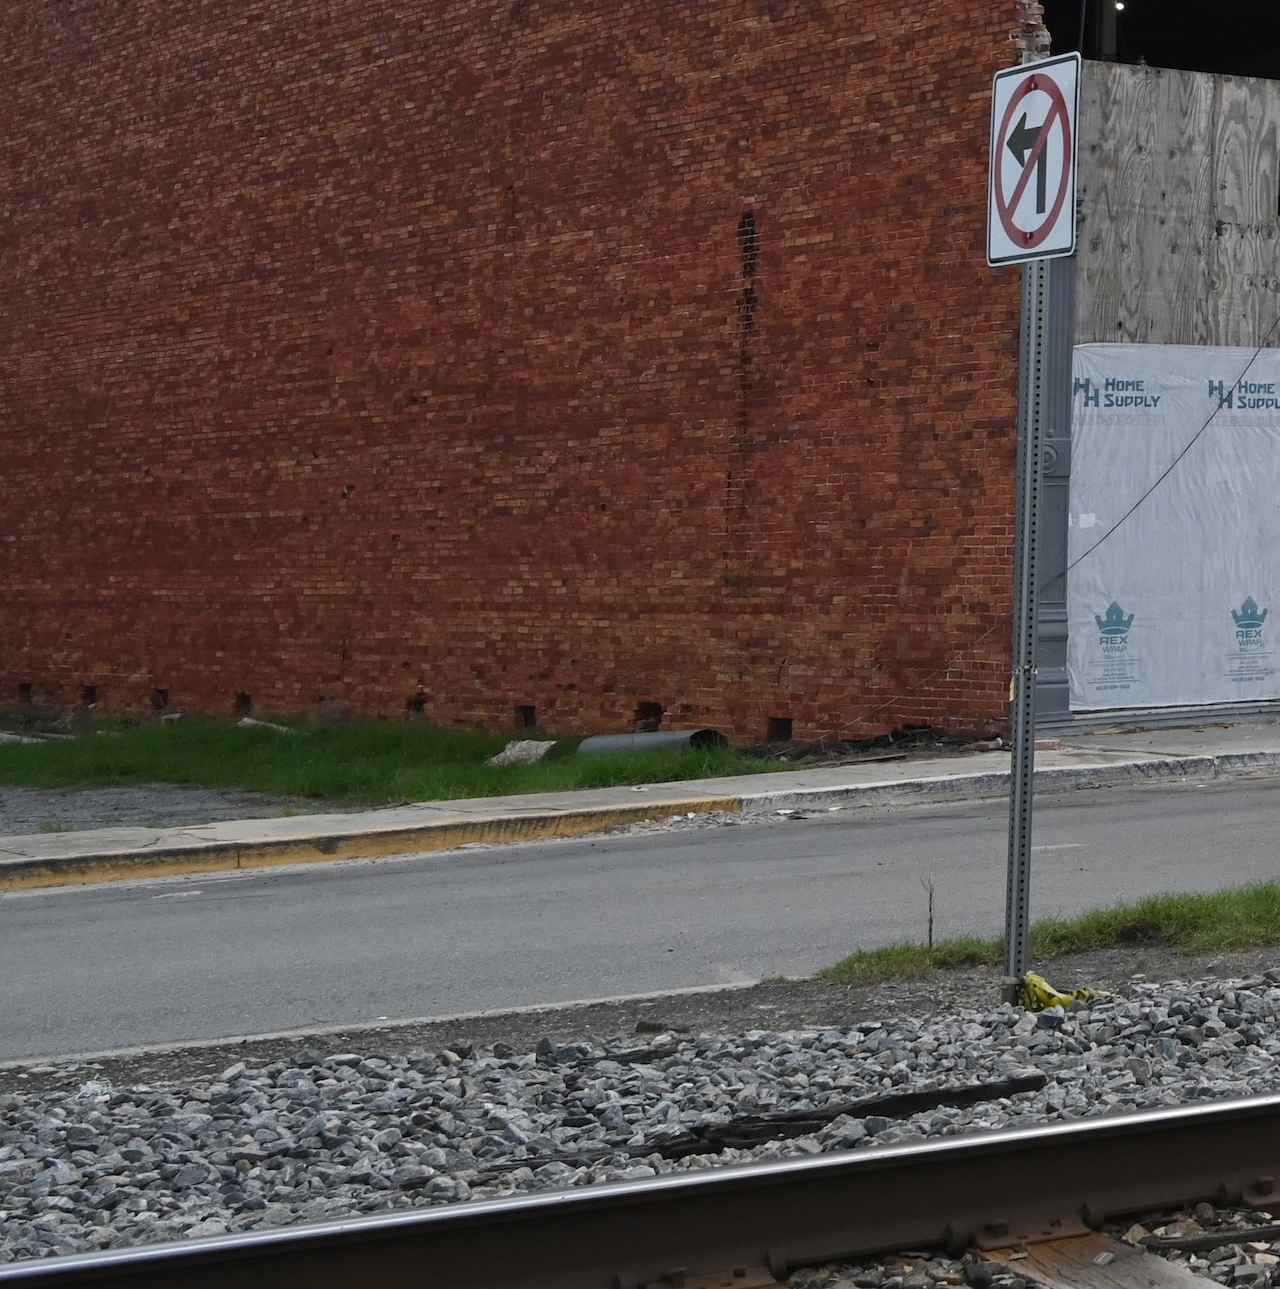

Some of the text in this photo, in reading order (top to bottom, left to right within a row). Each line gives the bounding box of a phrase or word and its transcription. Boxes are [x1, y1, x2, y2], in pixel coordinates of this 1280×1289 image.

[1103, 393, 1160, 408] SUPPLY
[1235, 629, 1263, 639] REX
[1099, 635, 1129, 645] REX
